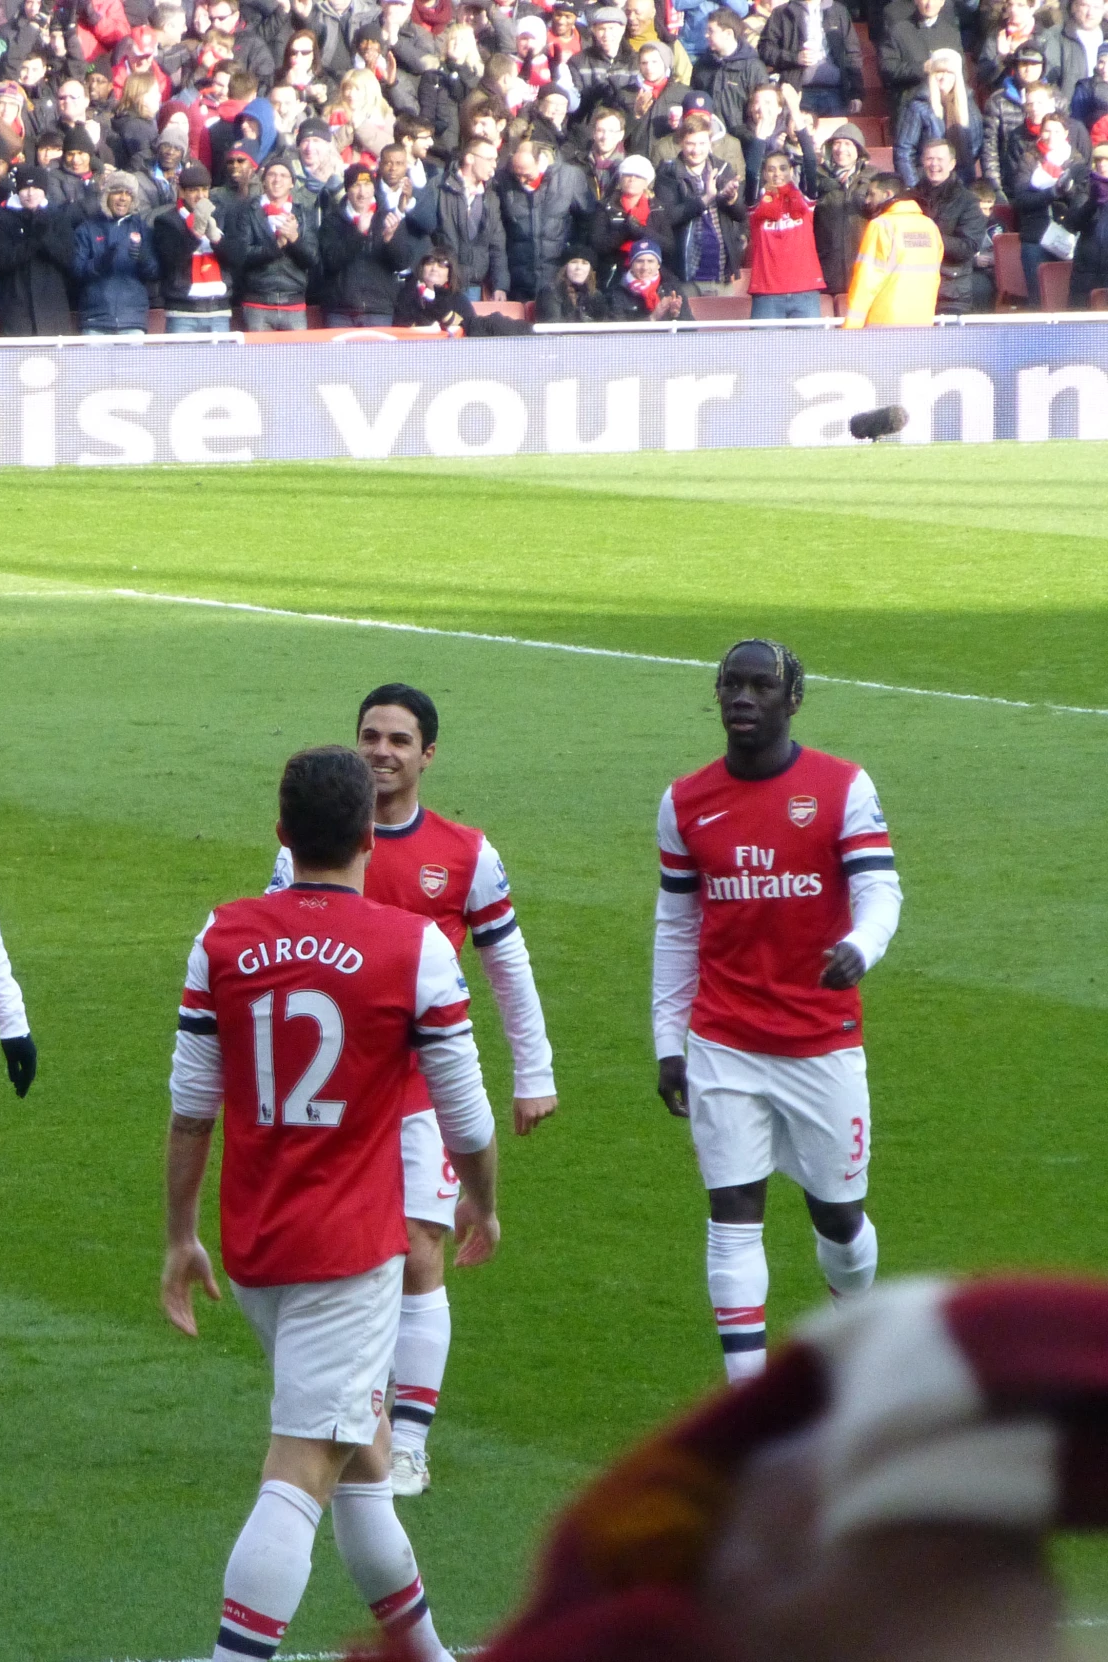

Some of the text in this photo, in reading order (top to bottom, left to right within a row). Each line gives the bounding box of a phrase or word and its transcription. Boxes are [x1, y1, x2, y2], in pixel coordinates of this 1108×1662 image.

[735, 845, 775, 871] Fly
[705, 871, 823, 900] Emirates
[237, 935, 364, 976] GIROUD
[249, 987, 347, 1128] 12
[850, 1116, 864, 1163] 3
